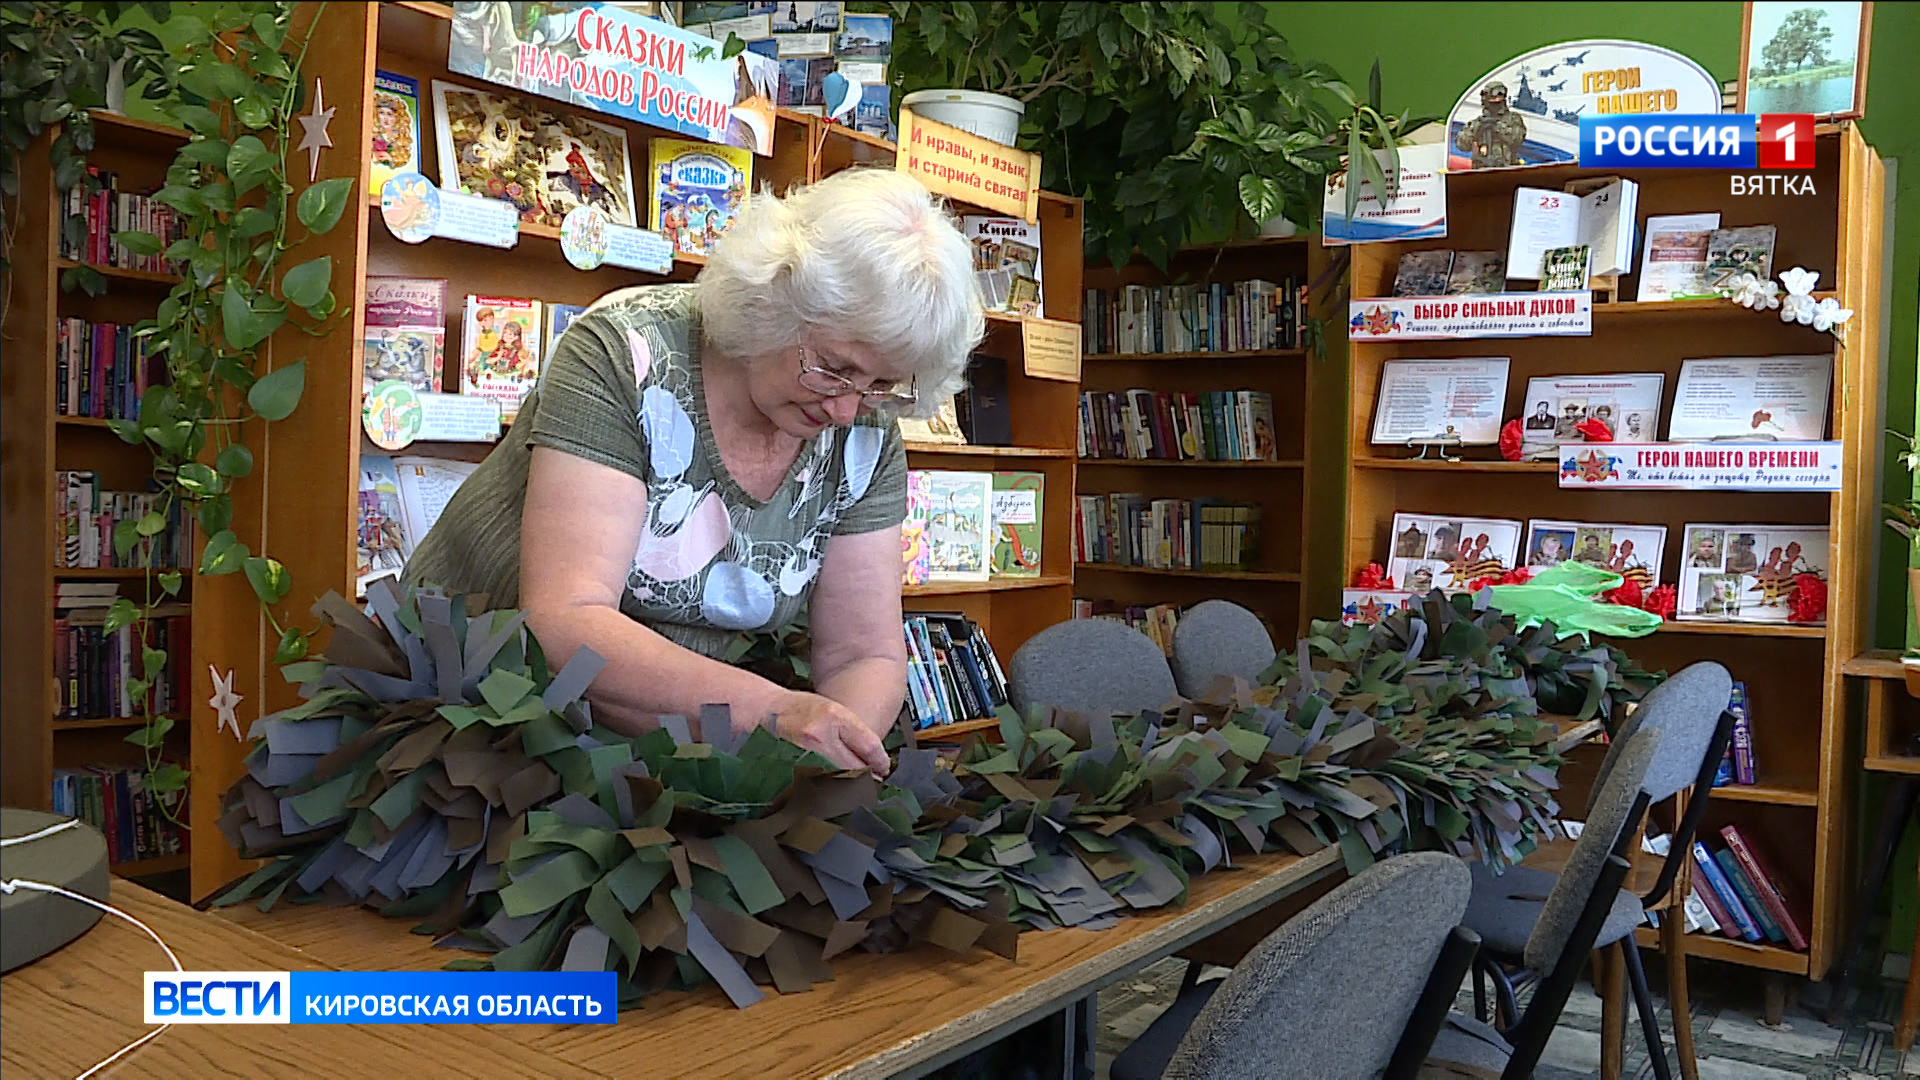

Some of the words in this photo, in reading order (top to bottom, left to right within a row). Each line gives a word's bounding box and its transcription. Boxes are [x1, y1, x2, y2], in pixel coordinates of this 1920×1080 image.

[1582, 66, 1641, 94] ГЕРОИ
[1597, 89, 1678, 114] НАШЕГО
[911, 125, 922, 144] И
[926, 135, 977, 165] нравы,
[980, 153, 989, 165] и
[992, 157, 1028, 183] язык,
[909, 155, 919, 170] и
[923, 161, 981, 188] старина
[985, 179, 1028, 202] святая
[1540, 196, 1560, 209] 23
[1595, 192, 1609, 208] 24
[979, 223, 1027, 236] Книга
[1414, 303, 1458, 320] ВЫБОР
[1463, 301, 1526, 318] СИЛЬНЫХ
[1530, 299, 1576, 317] ДУХОМ
[1637, 451, 1680, 468] ГЕРОИ
[1685, 451, 1743, 468] НАШЕГО
[1749, 451, 1819, 468] ВРЕМЕНИ
